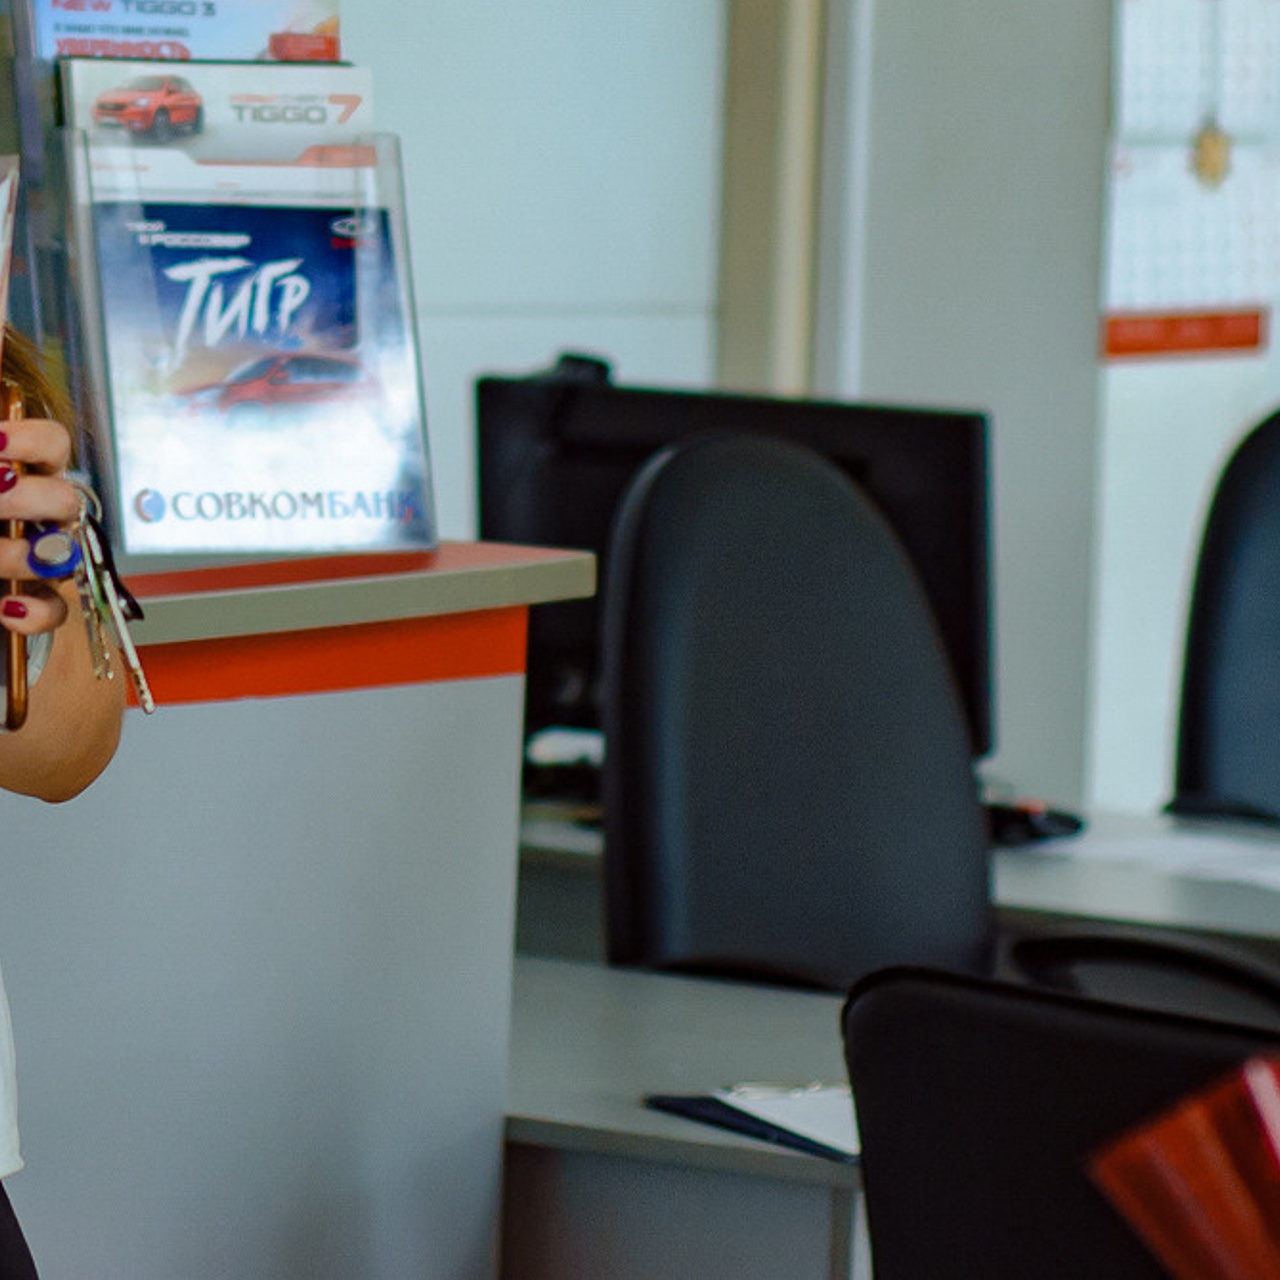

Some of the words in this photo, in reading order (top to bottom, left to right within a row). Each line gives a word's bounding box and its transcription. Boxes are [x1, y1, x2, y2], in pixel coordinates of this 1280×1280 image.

[120, 0, 197, 16] TIGGO
[202, 1, 216, 16] 3
[231, 104, 327, 124] TIGGO
[328, 93, 363, 125] 7
[163, 257, 311, 372] ТИГР
